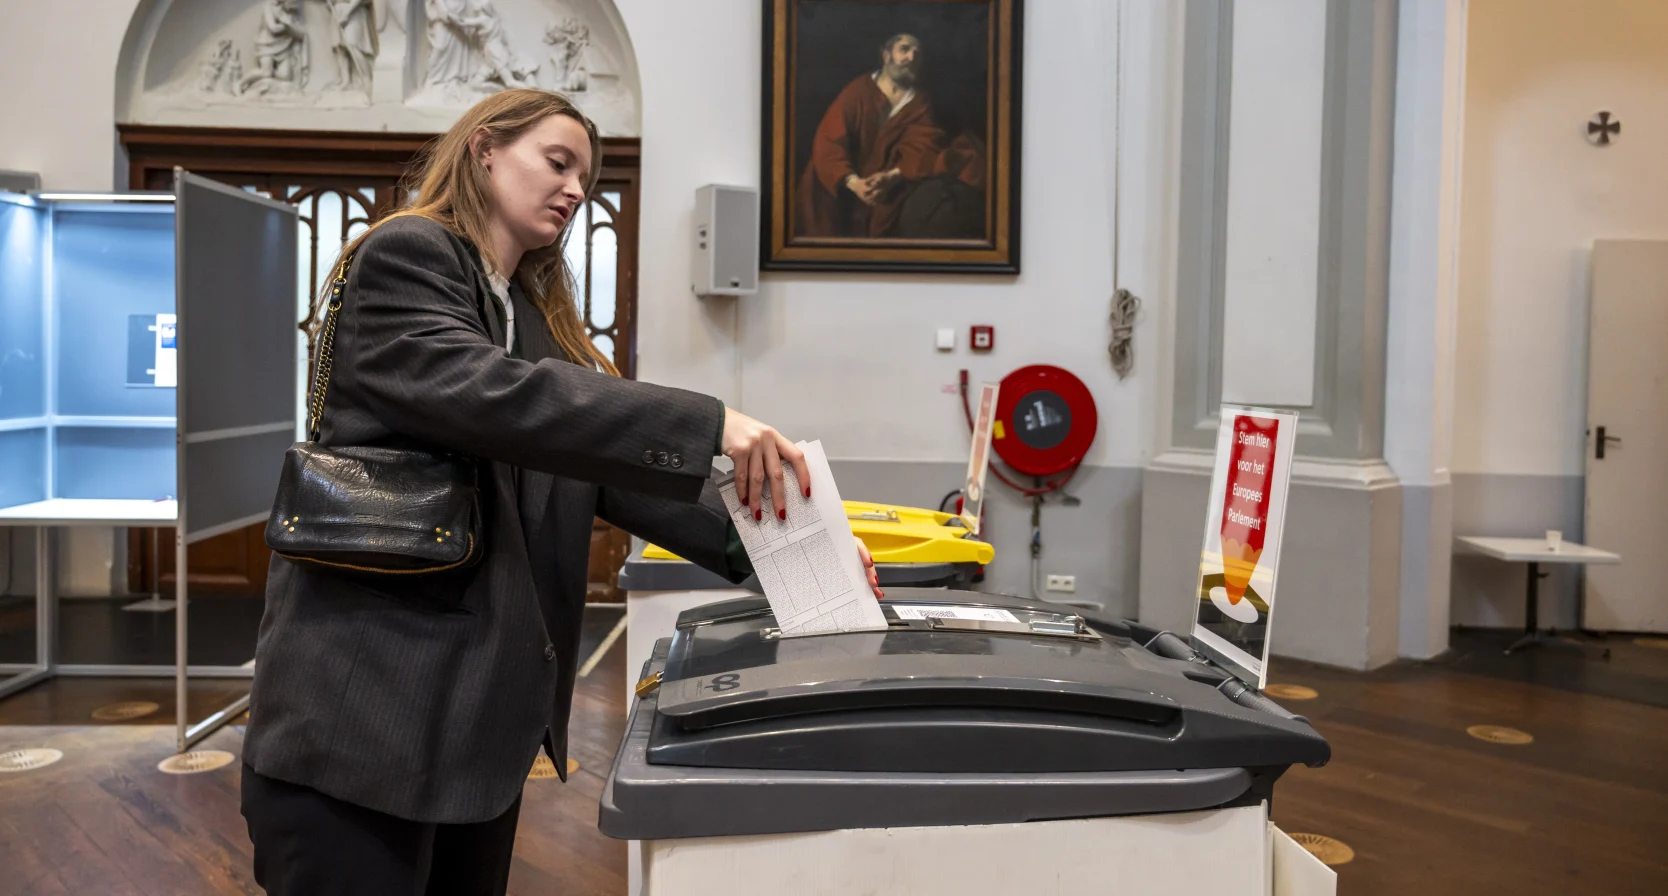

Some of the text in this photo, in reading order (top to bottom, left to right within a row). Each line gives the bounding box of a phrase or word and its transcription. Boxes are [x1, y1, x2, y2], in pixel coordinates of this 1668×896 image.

[1238, 430, 1270, 449] Stem hier
[1237, 459, 1265, 475] voor het
[1232, 482, 1263, 503] Europees
[1228, 507, 1261, 530] Parlement
